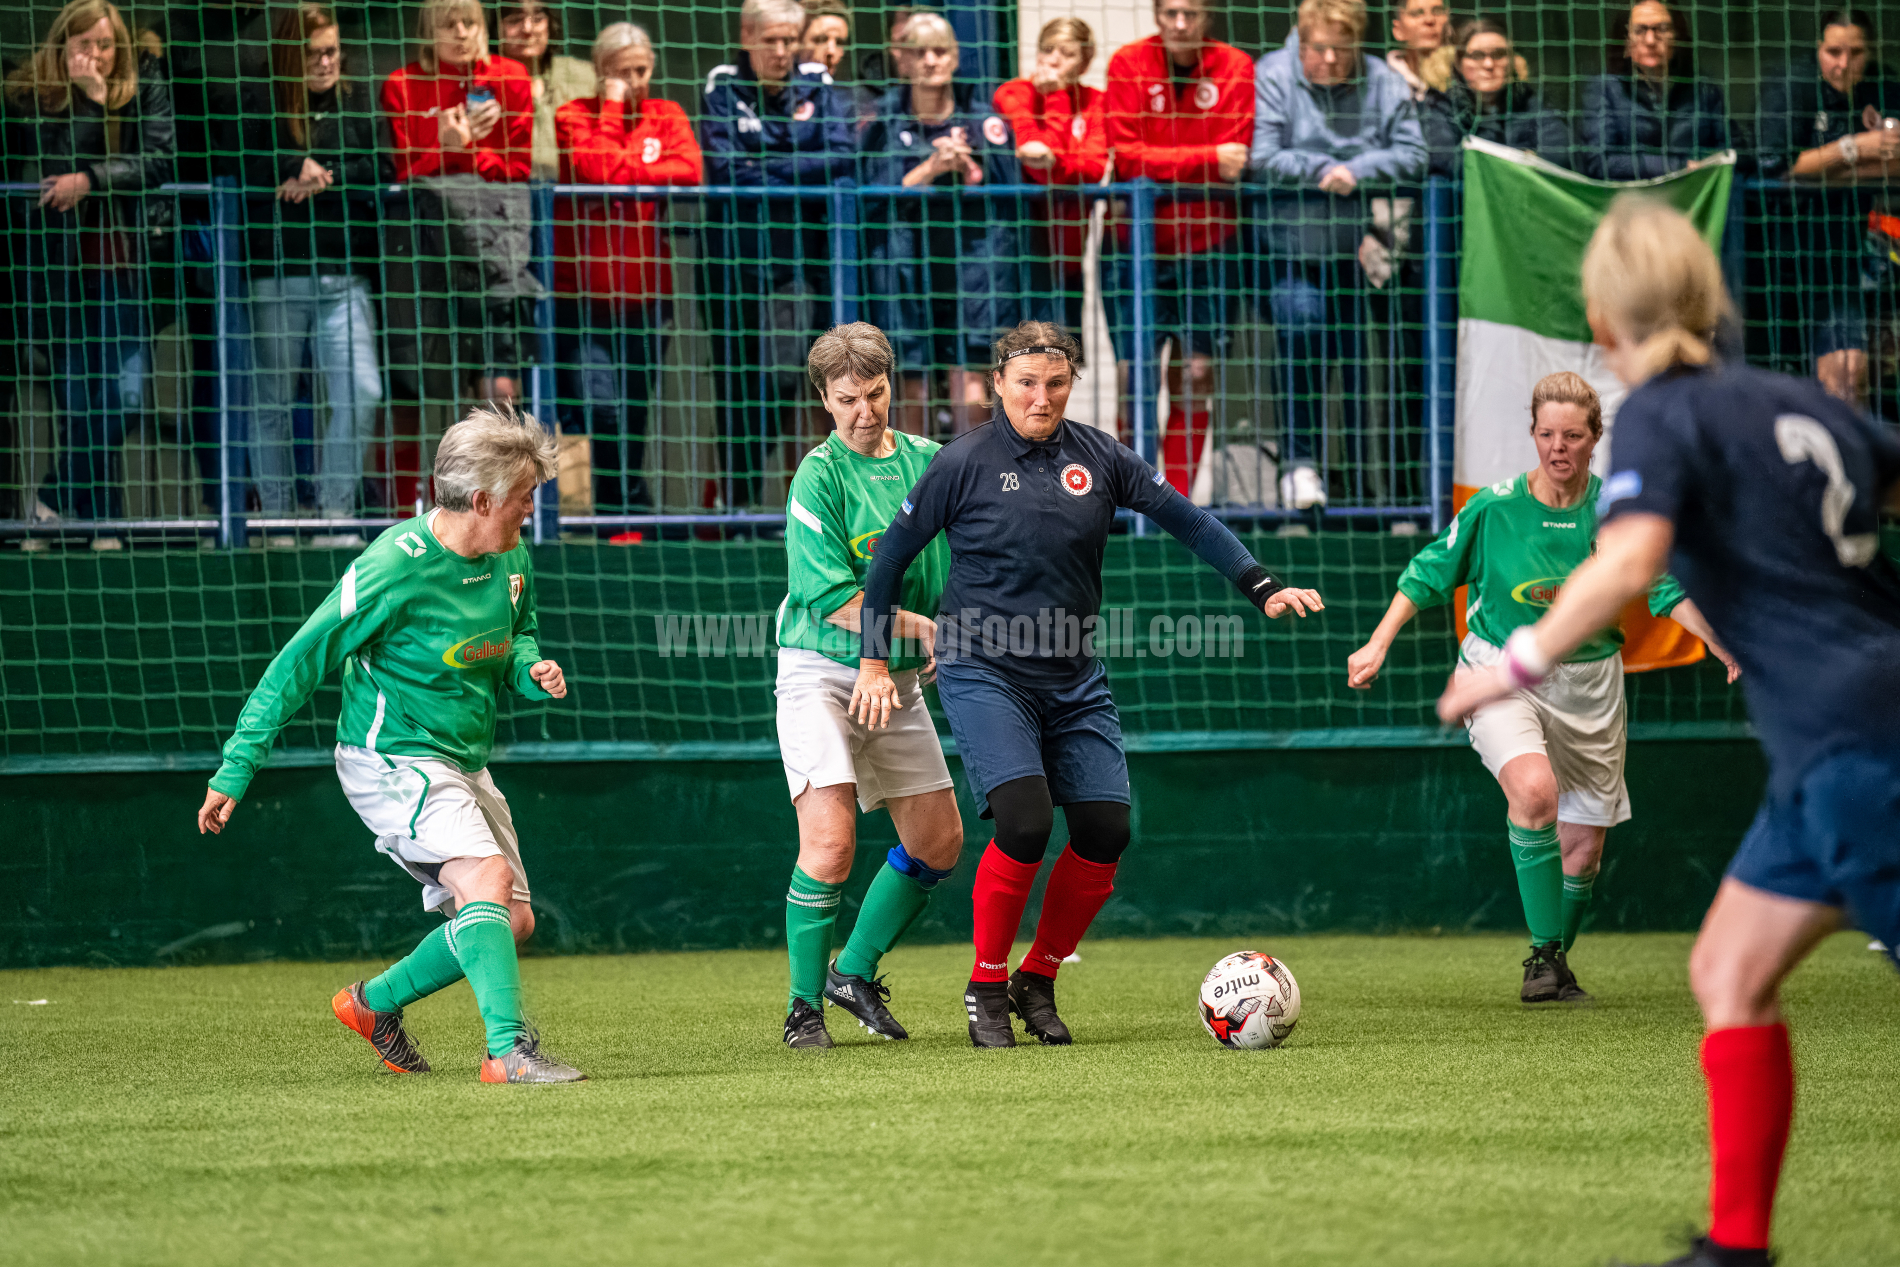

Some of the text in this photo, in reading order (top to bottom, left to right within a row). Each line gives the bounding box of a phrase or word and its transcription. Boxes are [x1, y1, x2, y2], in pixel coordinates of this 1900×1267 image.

[999, 472, 1020, 492] 28
[462, 573, 492, 585] STANNO
[1213, 973, 1261, 998] mitre
